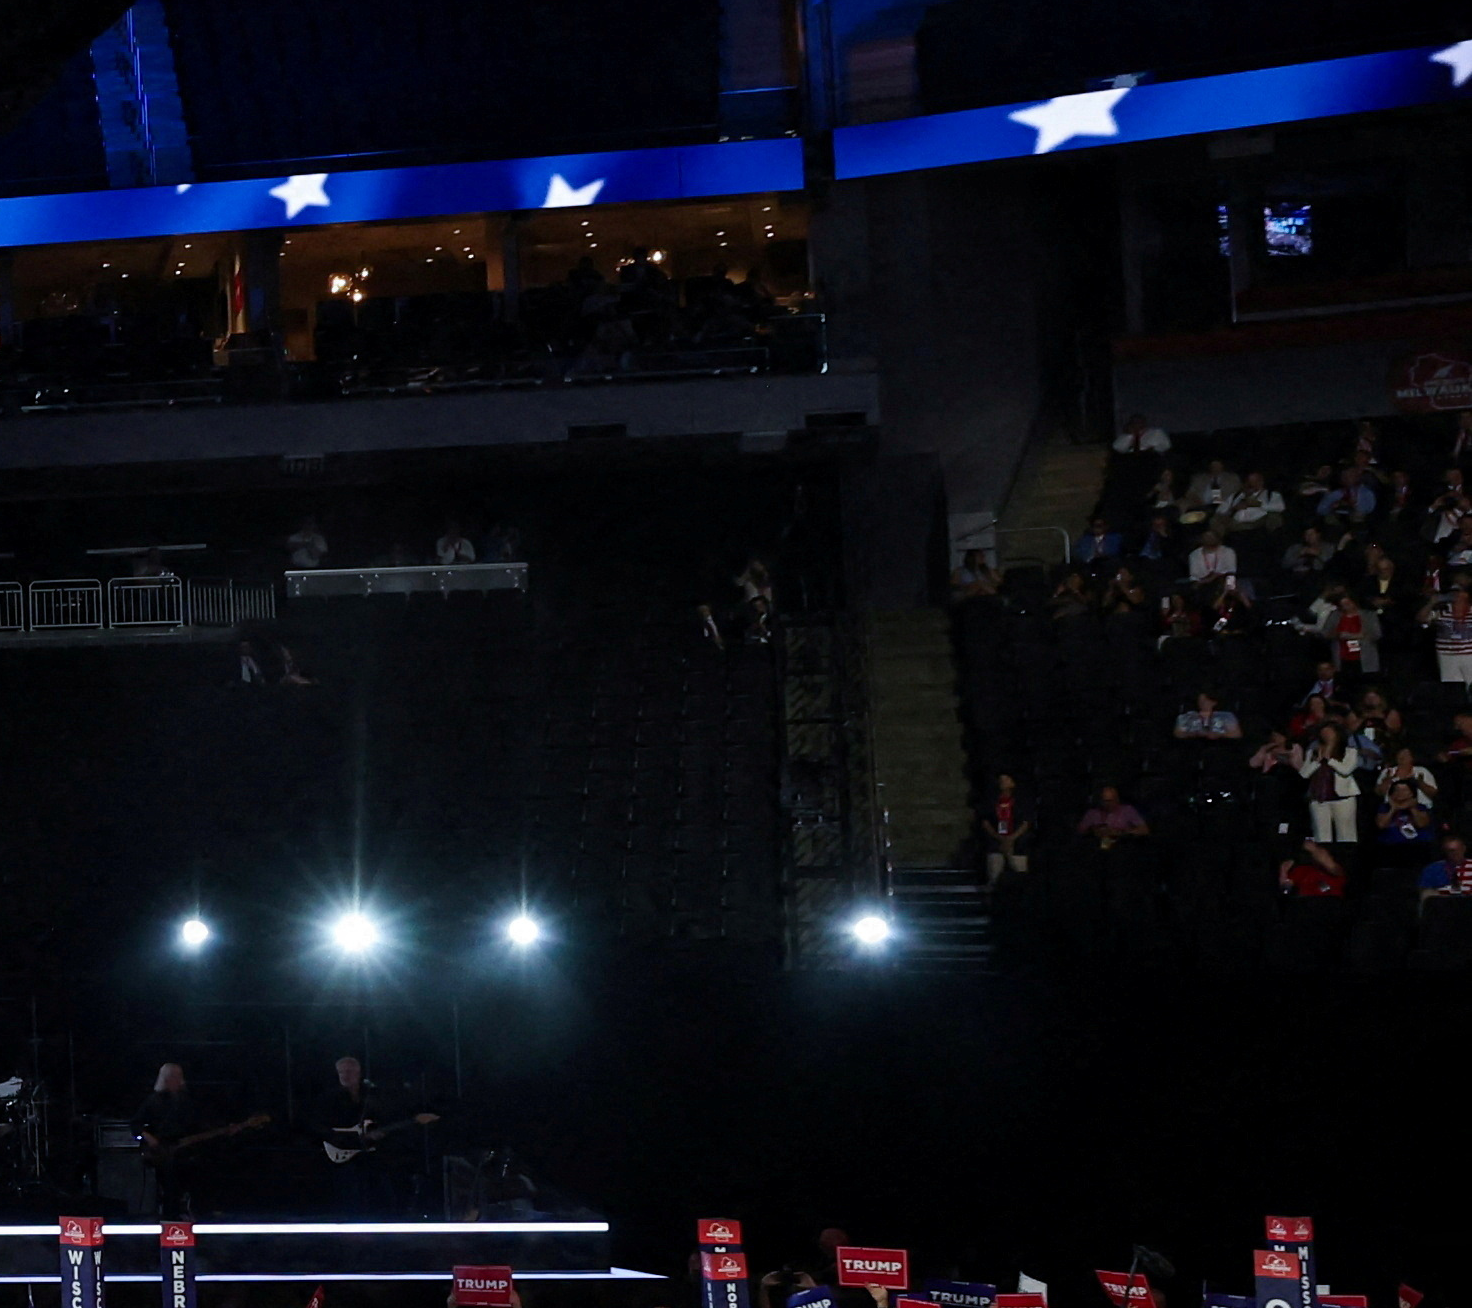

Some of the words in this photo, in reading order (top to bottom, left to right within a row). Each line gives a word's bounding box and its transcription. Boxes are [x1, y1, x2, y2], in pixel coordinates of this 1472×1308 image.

[843, 1261, 901, 1272] TRUMP
[456, 1278, 508, 1289] TRUMP
[930, 1292, 990, 1305] TRUMP
